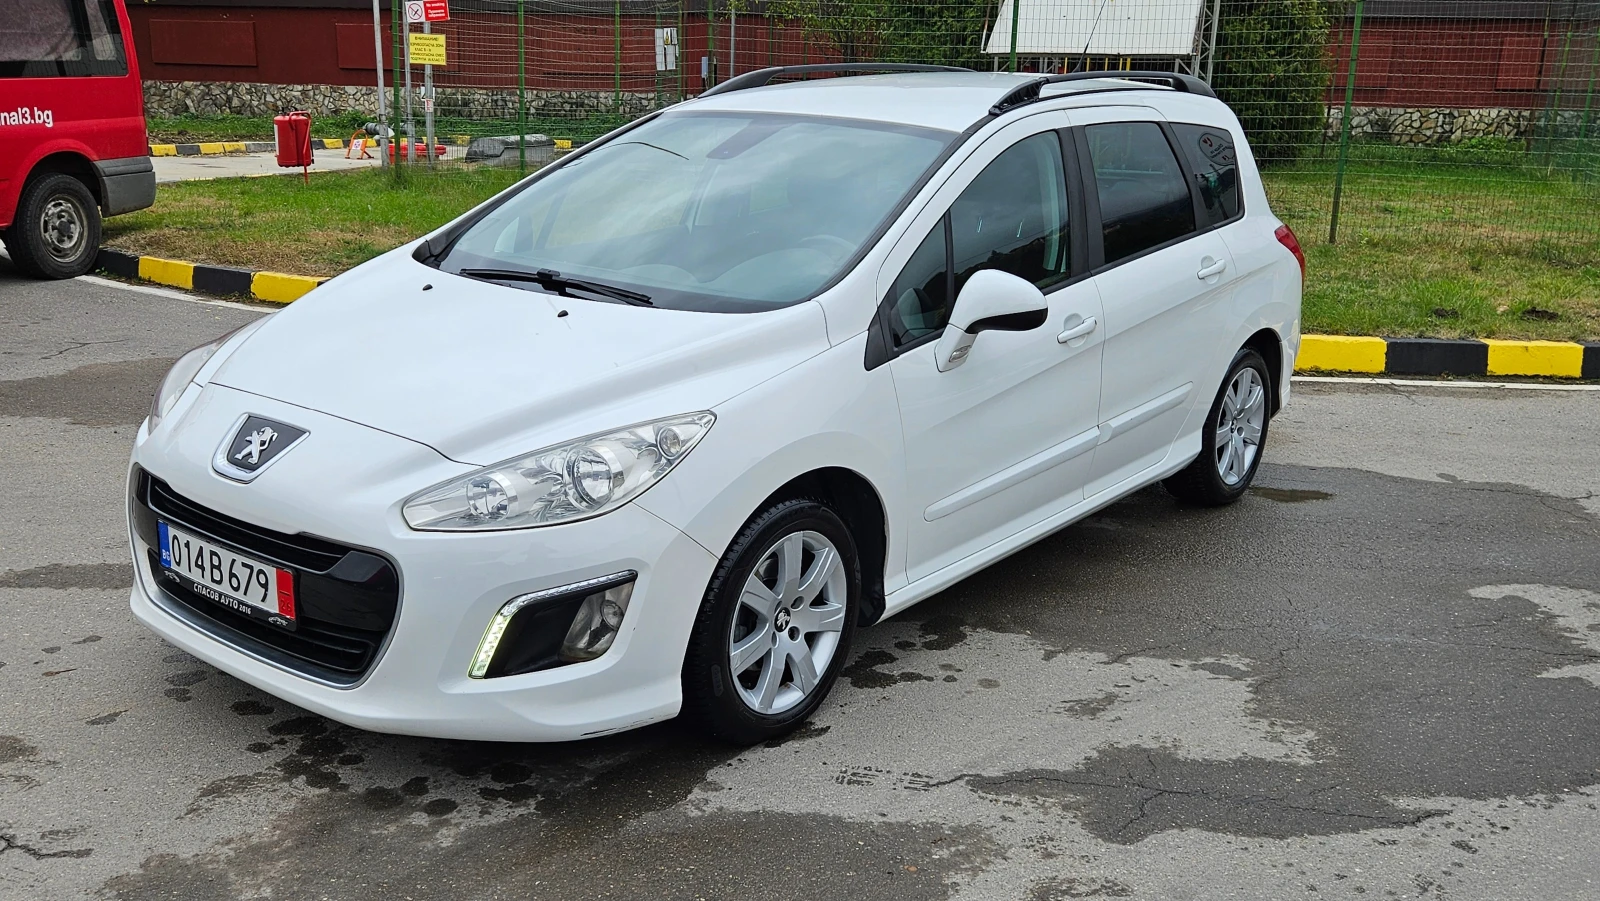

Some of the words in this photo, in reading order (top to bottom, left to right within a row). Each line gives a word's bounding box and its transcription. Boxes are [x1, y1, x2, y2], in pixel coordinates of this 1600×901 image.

[0, 106, 54, 128] nal3.bg
[162, 549, 170, 561] BG
[193, 583, 220, 602] СПАСОВ
[220, 595, 239, 609] АУТО
[239, 604, 252, 615] 2016
